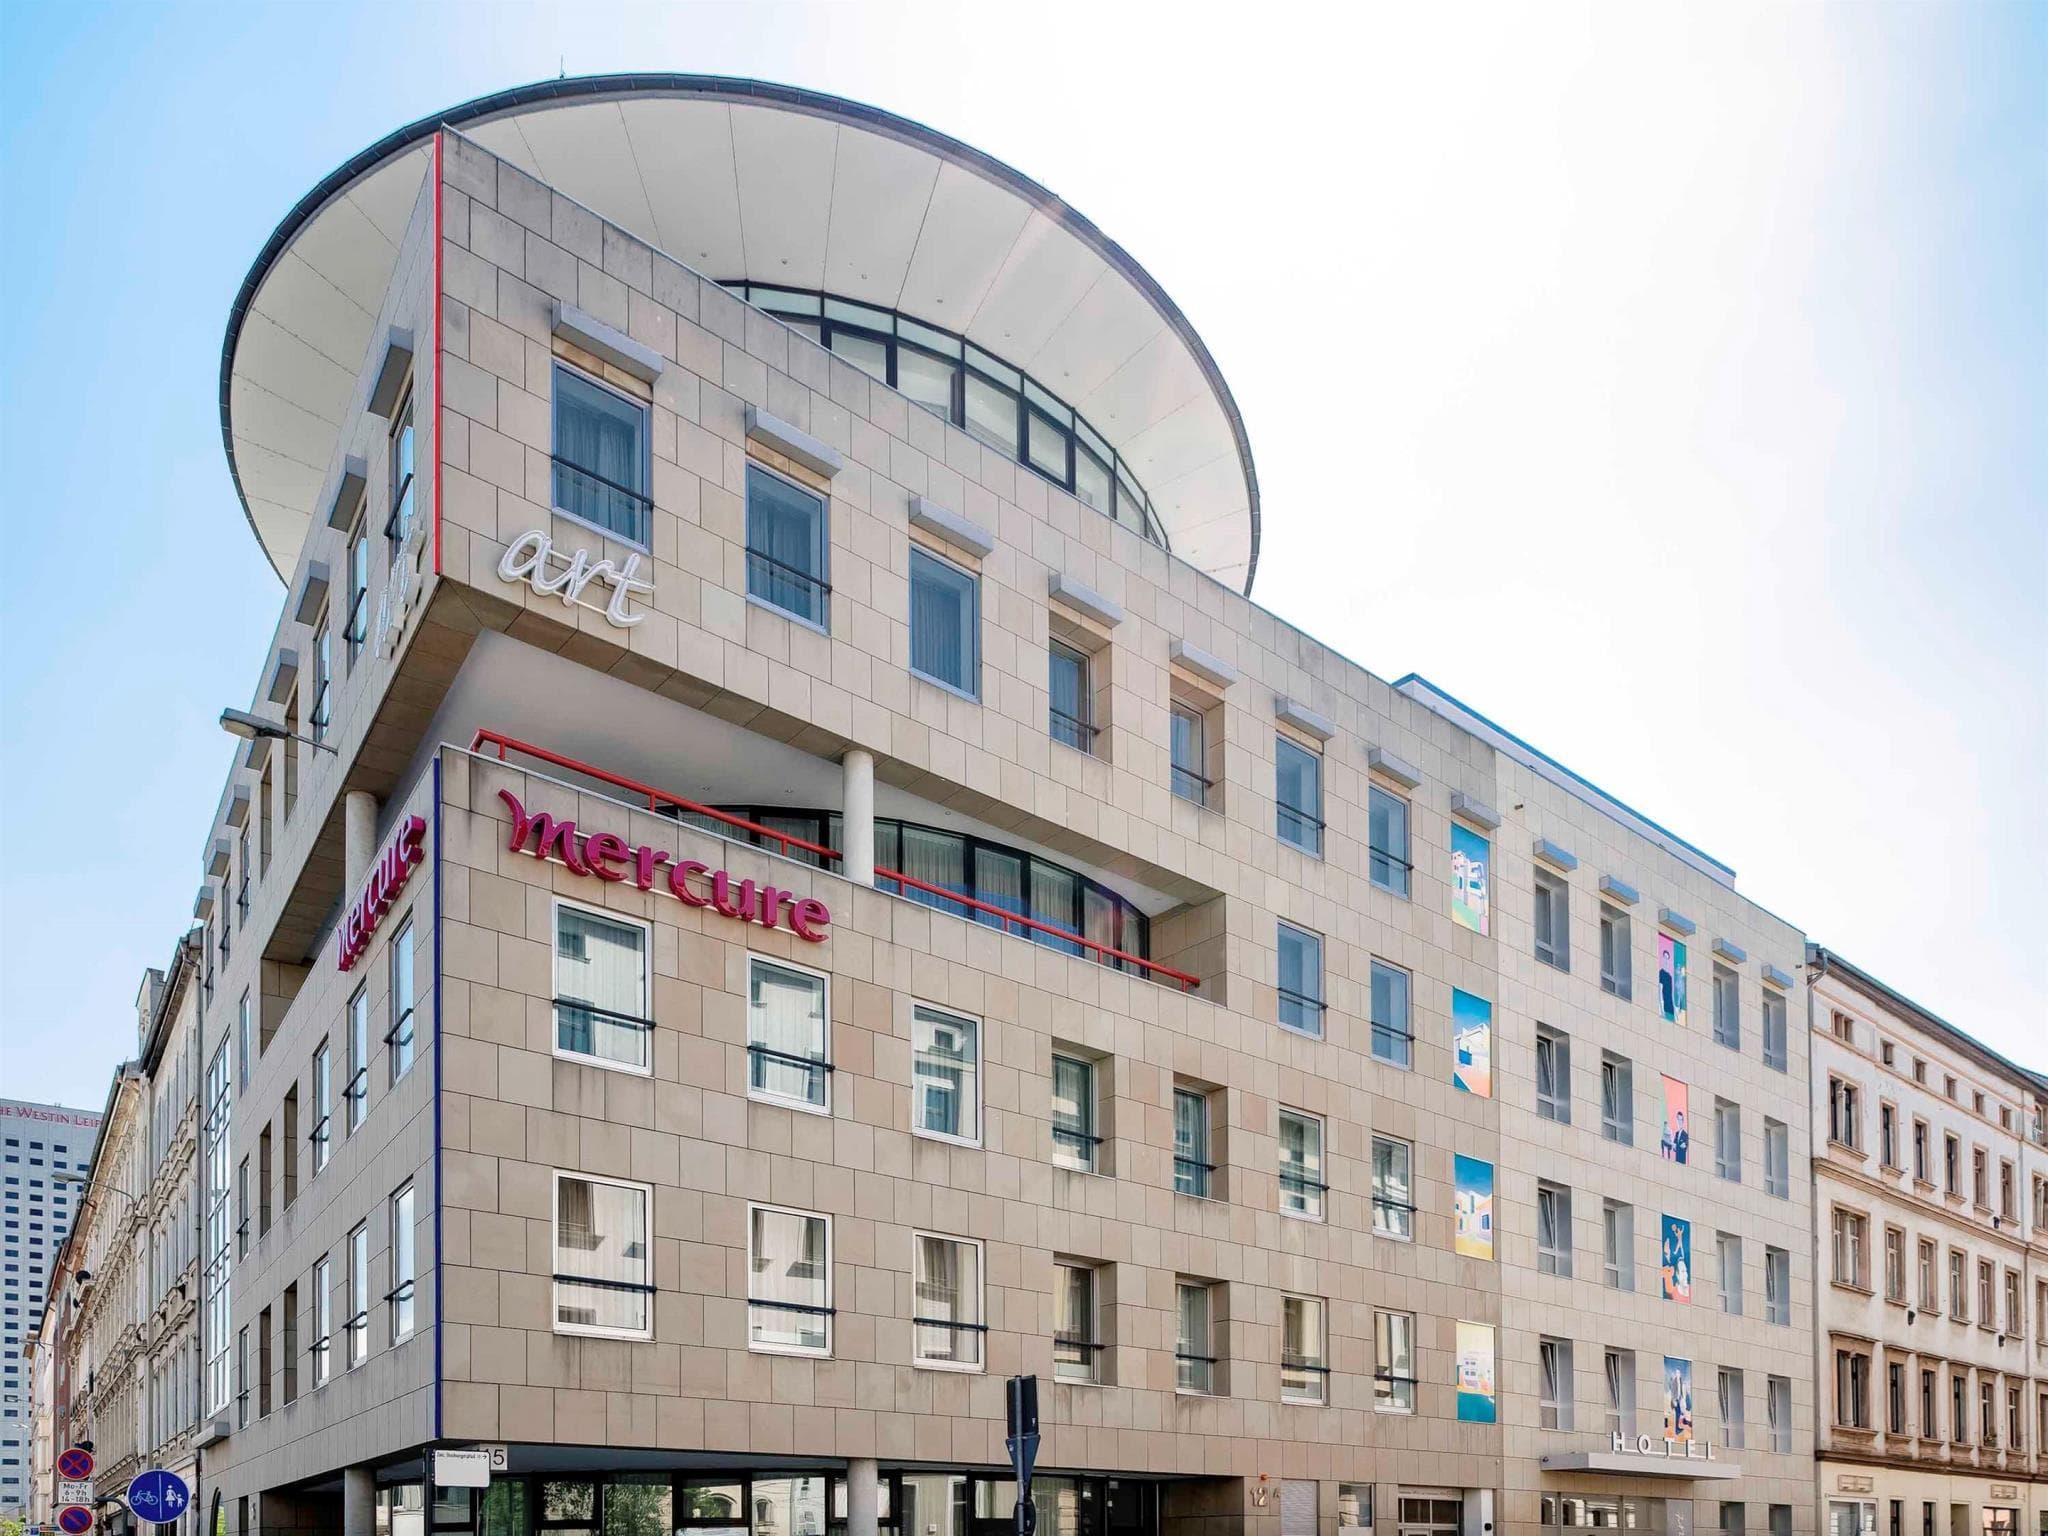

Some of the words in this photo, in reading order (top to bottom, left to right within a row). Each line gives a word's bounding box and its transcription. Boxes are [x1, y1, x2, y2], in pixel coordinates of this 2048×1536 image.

[498, 529, 656, 627] art
[498, 789, 831, 943] mercure
[1611, 1431, 1716, 1461] HOTEL
[1250, 1487, 1268, 1508] 12
